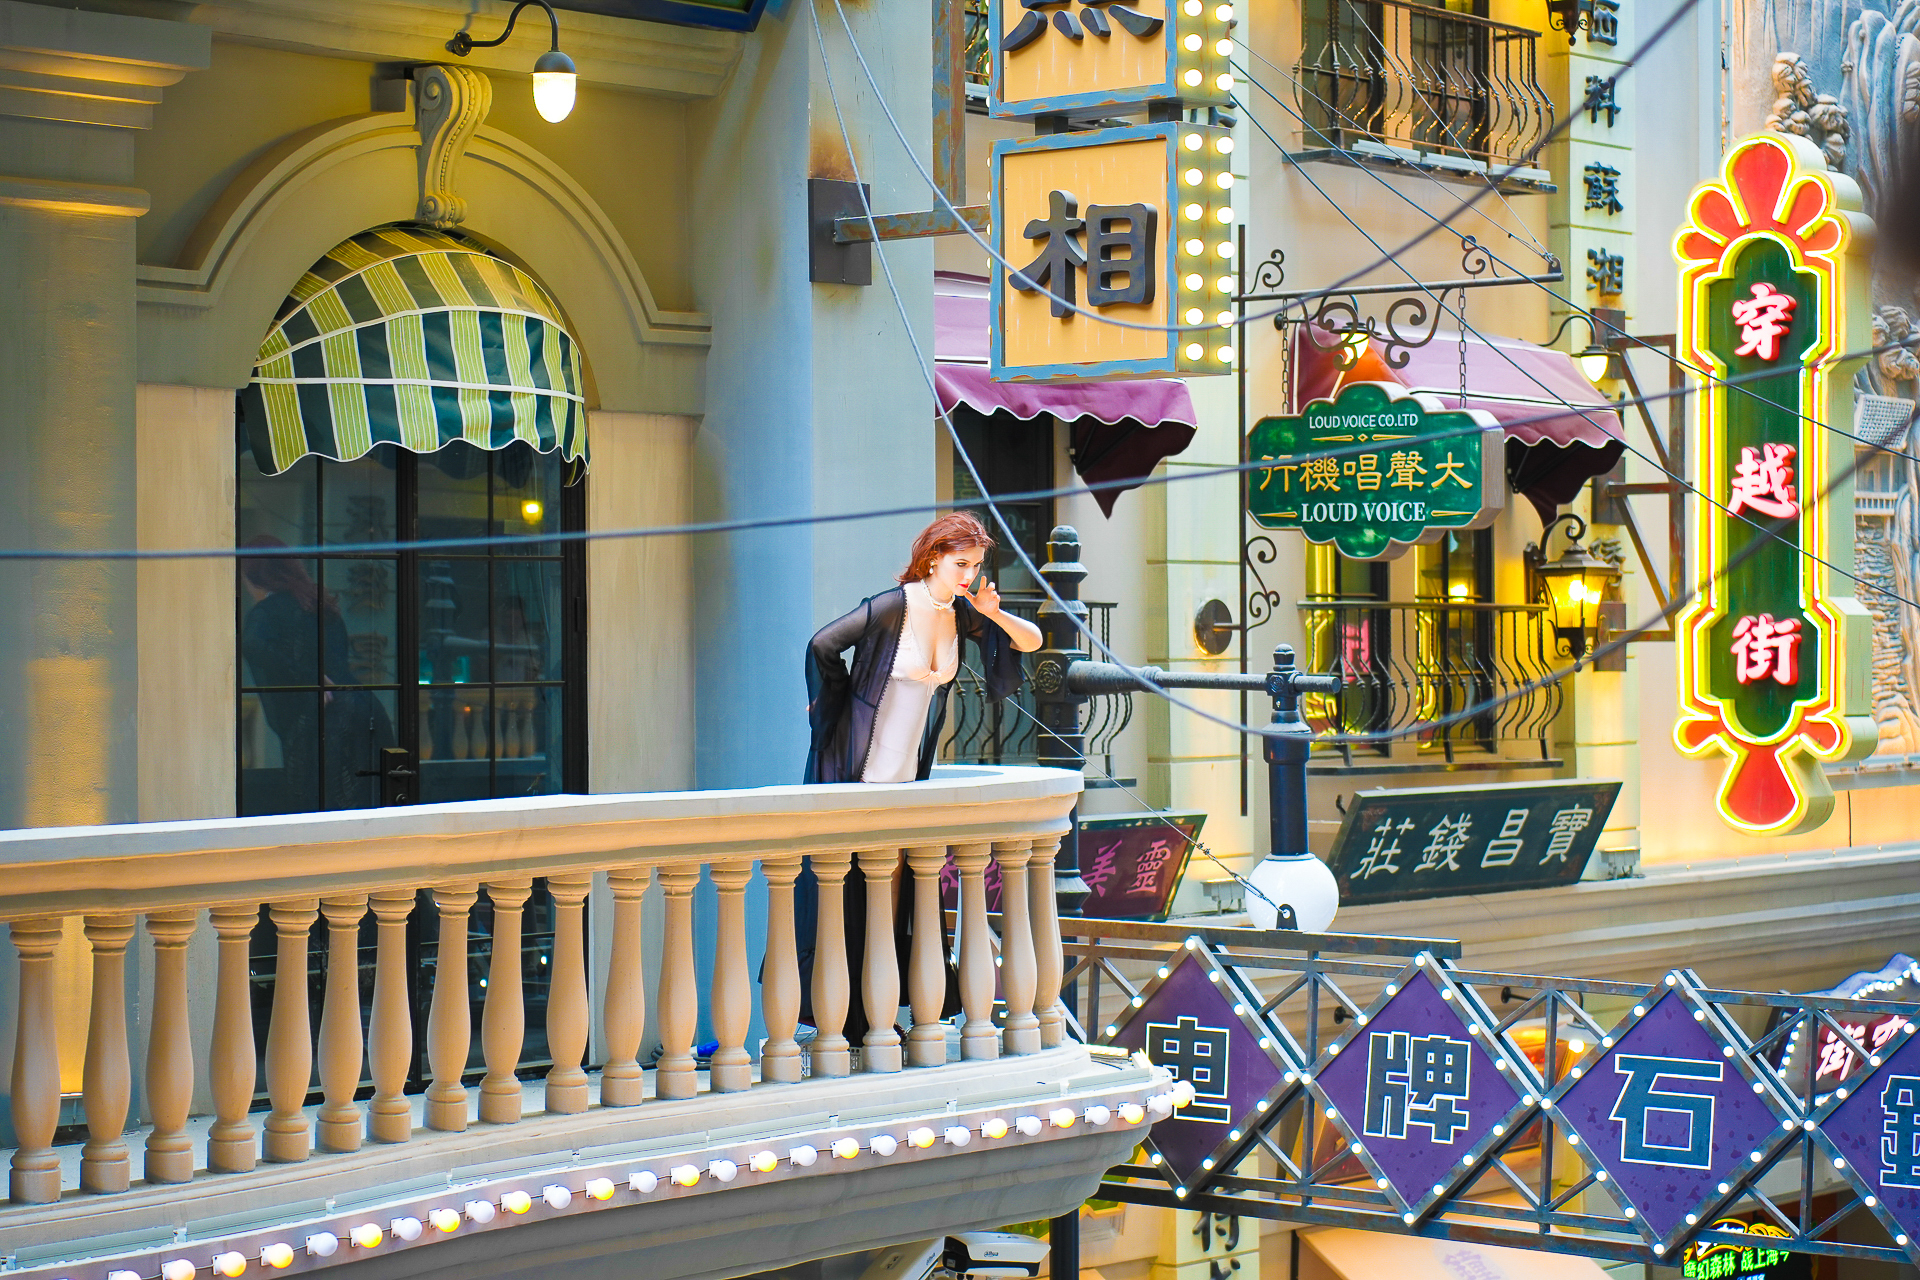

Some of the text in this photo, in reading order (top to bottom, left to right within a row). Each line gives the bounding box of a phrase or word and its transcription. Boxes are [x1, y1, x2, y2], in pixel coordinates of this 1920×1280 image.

[1309, 412, 1419, 429] LOUD VOICE CO.LTD
[1726, 282, 1802, 686] 穿越街
[1301, 501, 1426, 523] LOUD VOICE
